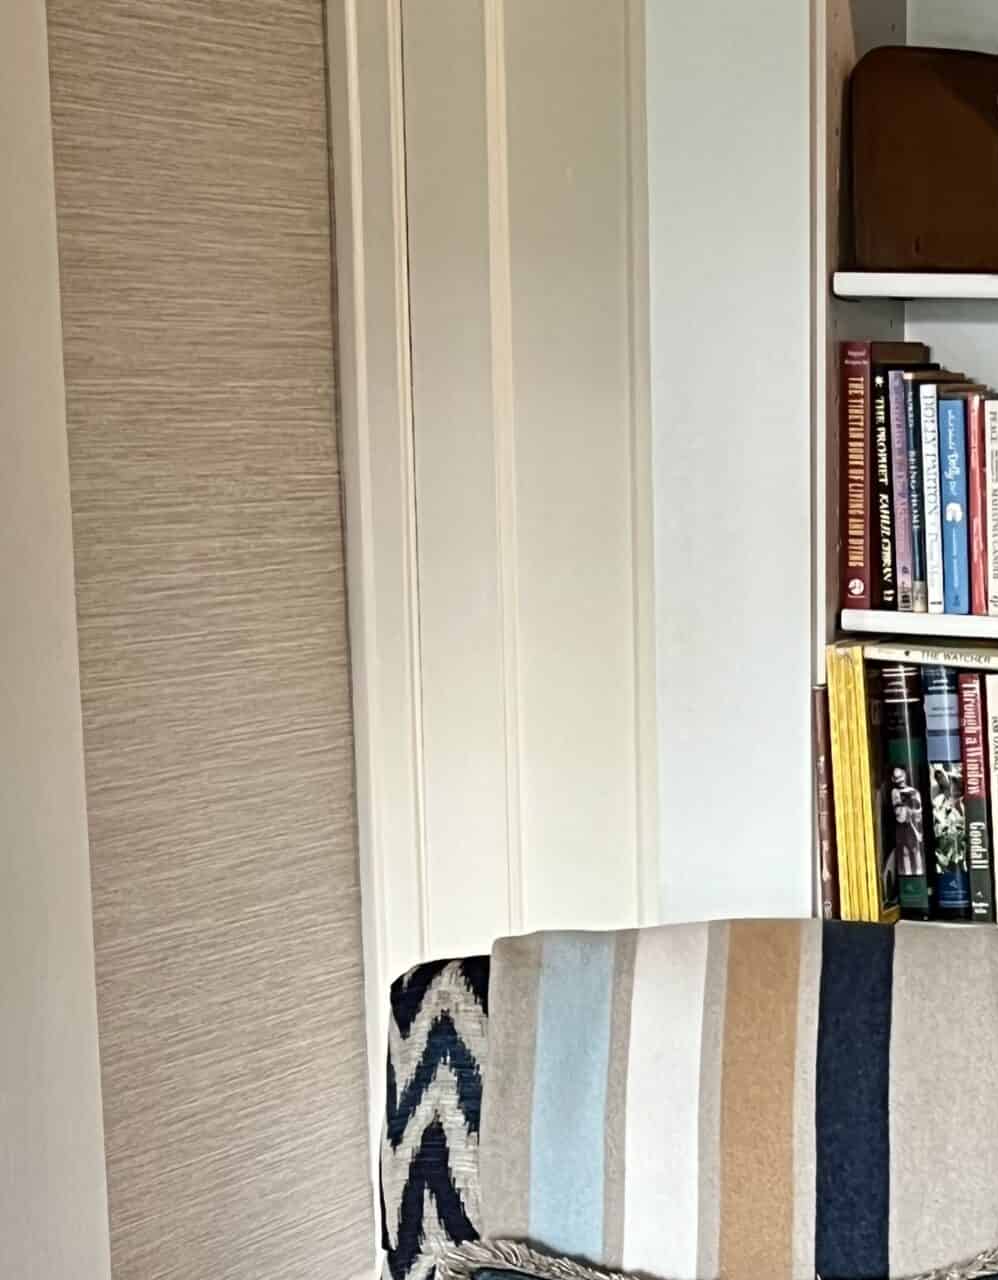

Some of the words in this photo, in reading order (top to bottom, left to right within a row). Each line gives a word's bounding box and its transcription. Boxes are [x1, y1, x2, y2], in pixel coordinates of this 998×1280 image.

[848, 377, 865, 394] THE
[848, 399, 865, 439] TIBETAN
[875, 396, 887, 424] THE
[923, 395, 938, 446] DOLLY
[989, 410, 998, 443] PEACE
[848, 441, 865, 466] BOOK
[875, 427, 889, 485] PROPHET
[848, 469, 864, 481] OF
[925, 455, 940, 516] PARTON
[848, 483, 864, 516] LIVING
[848, 518, 864, 537] AND
[848, 538, 864, 567] DYING
[921, 650, 938, 660] THE
[942, 652, 991, 665] WATCHER
[962, 679, 980, 735] Through
[965, 737, 980, 745] a
[965, 745, 983, 795] Window
[968, 821, 989, 870] Goodall
